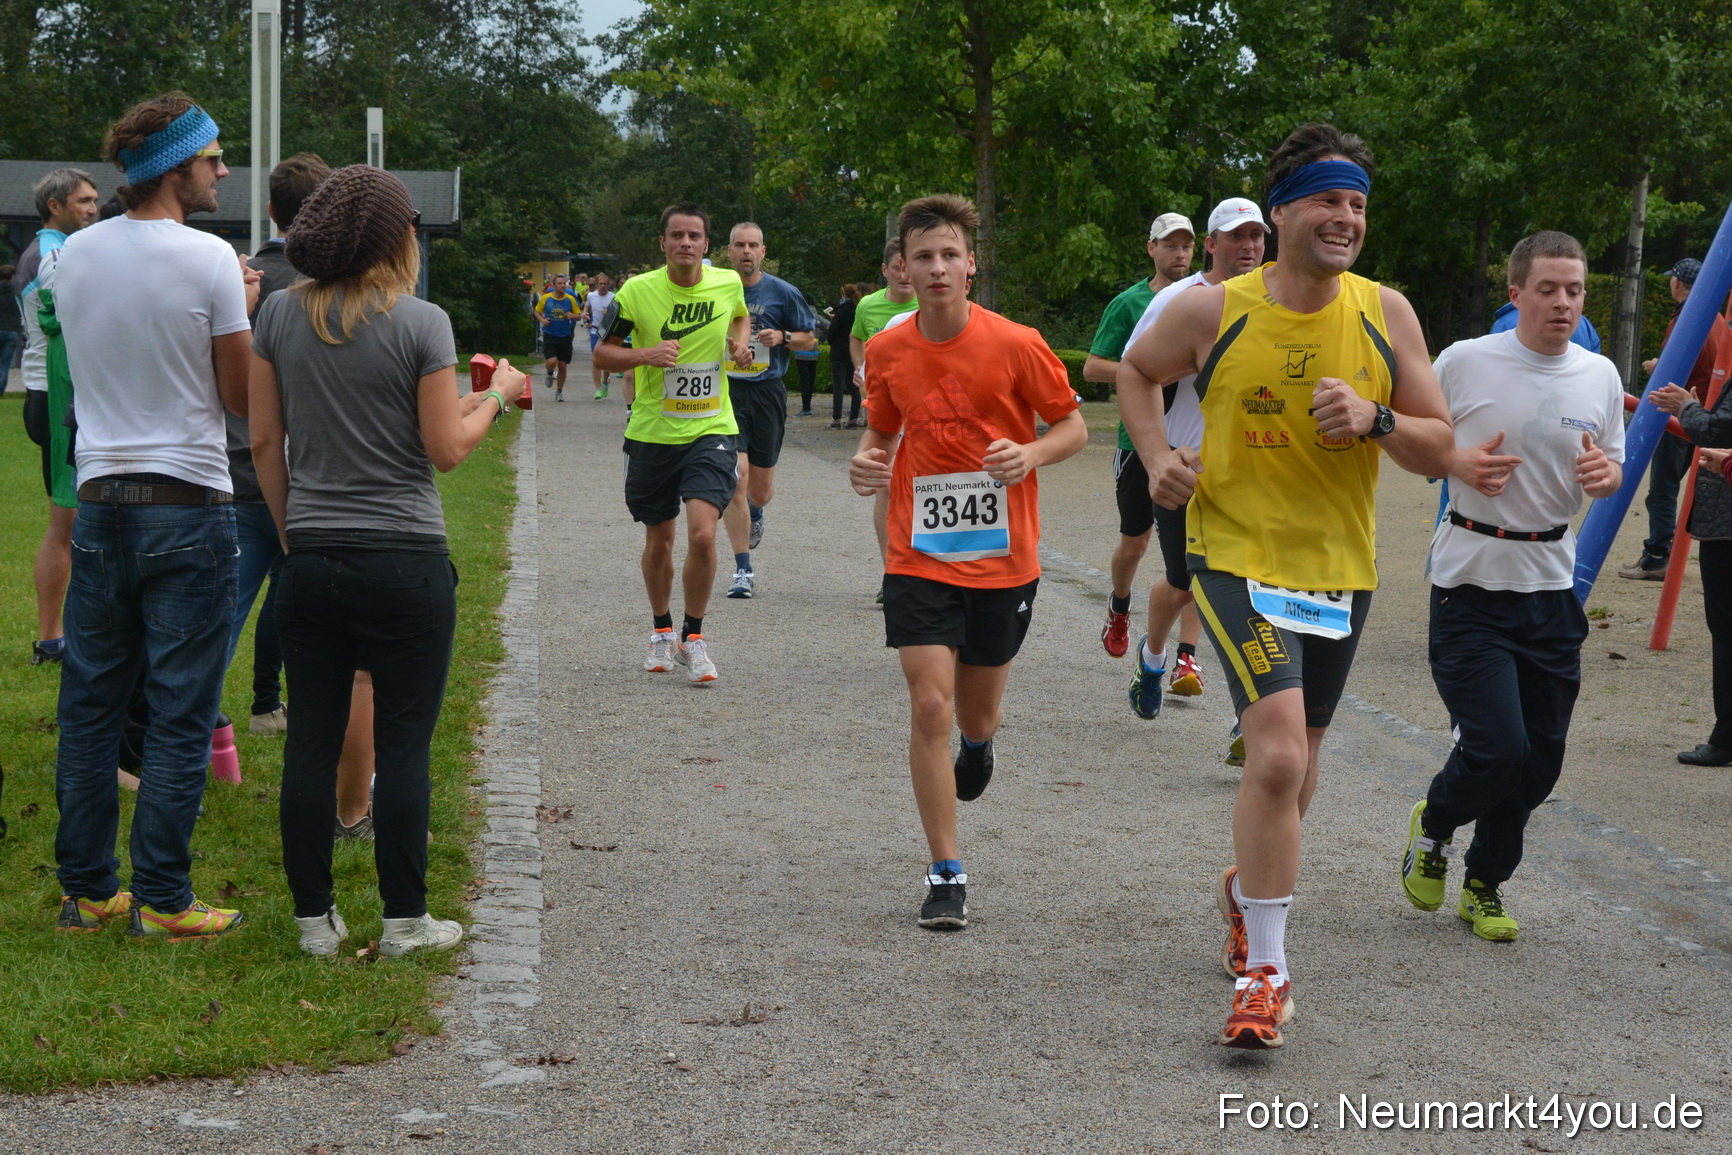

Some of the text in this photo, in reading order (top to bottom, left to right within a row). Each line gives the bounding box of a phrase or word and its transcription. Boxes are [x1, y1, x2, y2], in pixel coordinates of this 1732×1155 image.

[670, 301, 715, 324] RUN
[676, 376, 712, 397] 289
[676, 402, 710, 411] Christian
[1244, 431, 1289, 443] M & S
[915, 480, 990, 494] PARTL Neumarkt
[923, 493, 998, 530] 3343
[1284, 600, 1321, 623] Alfred
[1256, 622, 1285, 658] Run!
[1248, 641, 1267, 671] Team
